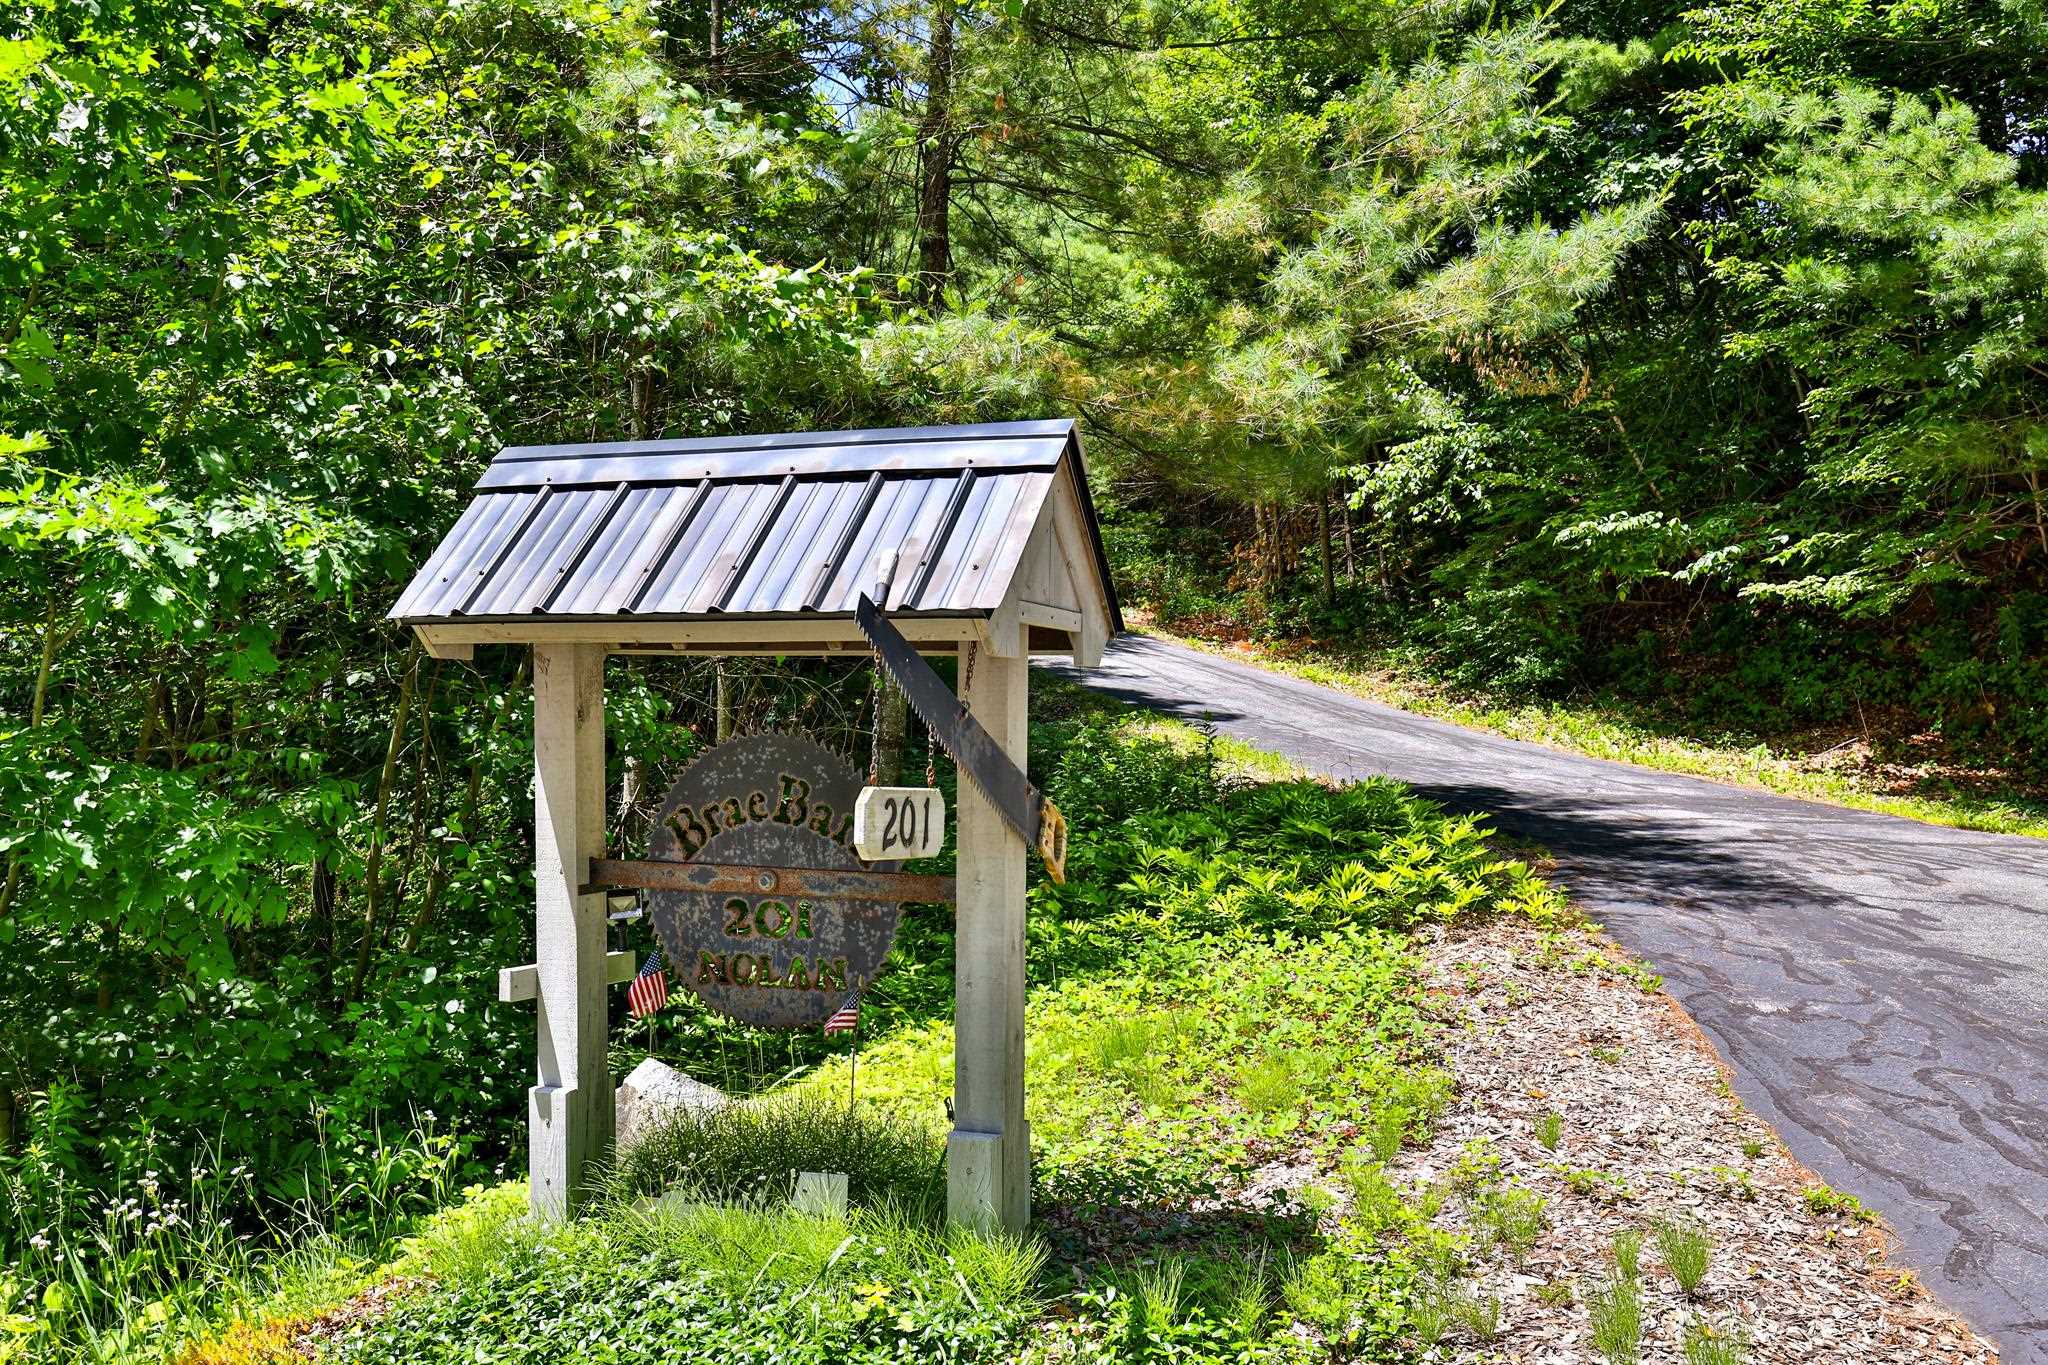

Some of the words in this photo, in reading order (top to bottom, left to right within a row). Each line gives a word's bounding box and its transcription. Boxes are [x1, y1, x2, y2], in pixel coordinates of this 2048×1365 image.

[882, 796, 931, 852] 201
[724, 899, 815, 939] 201
[697, 950, 849, 992] NOLAN
